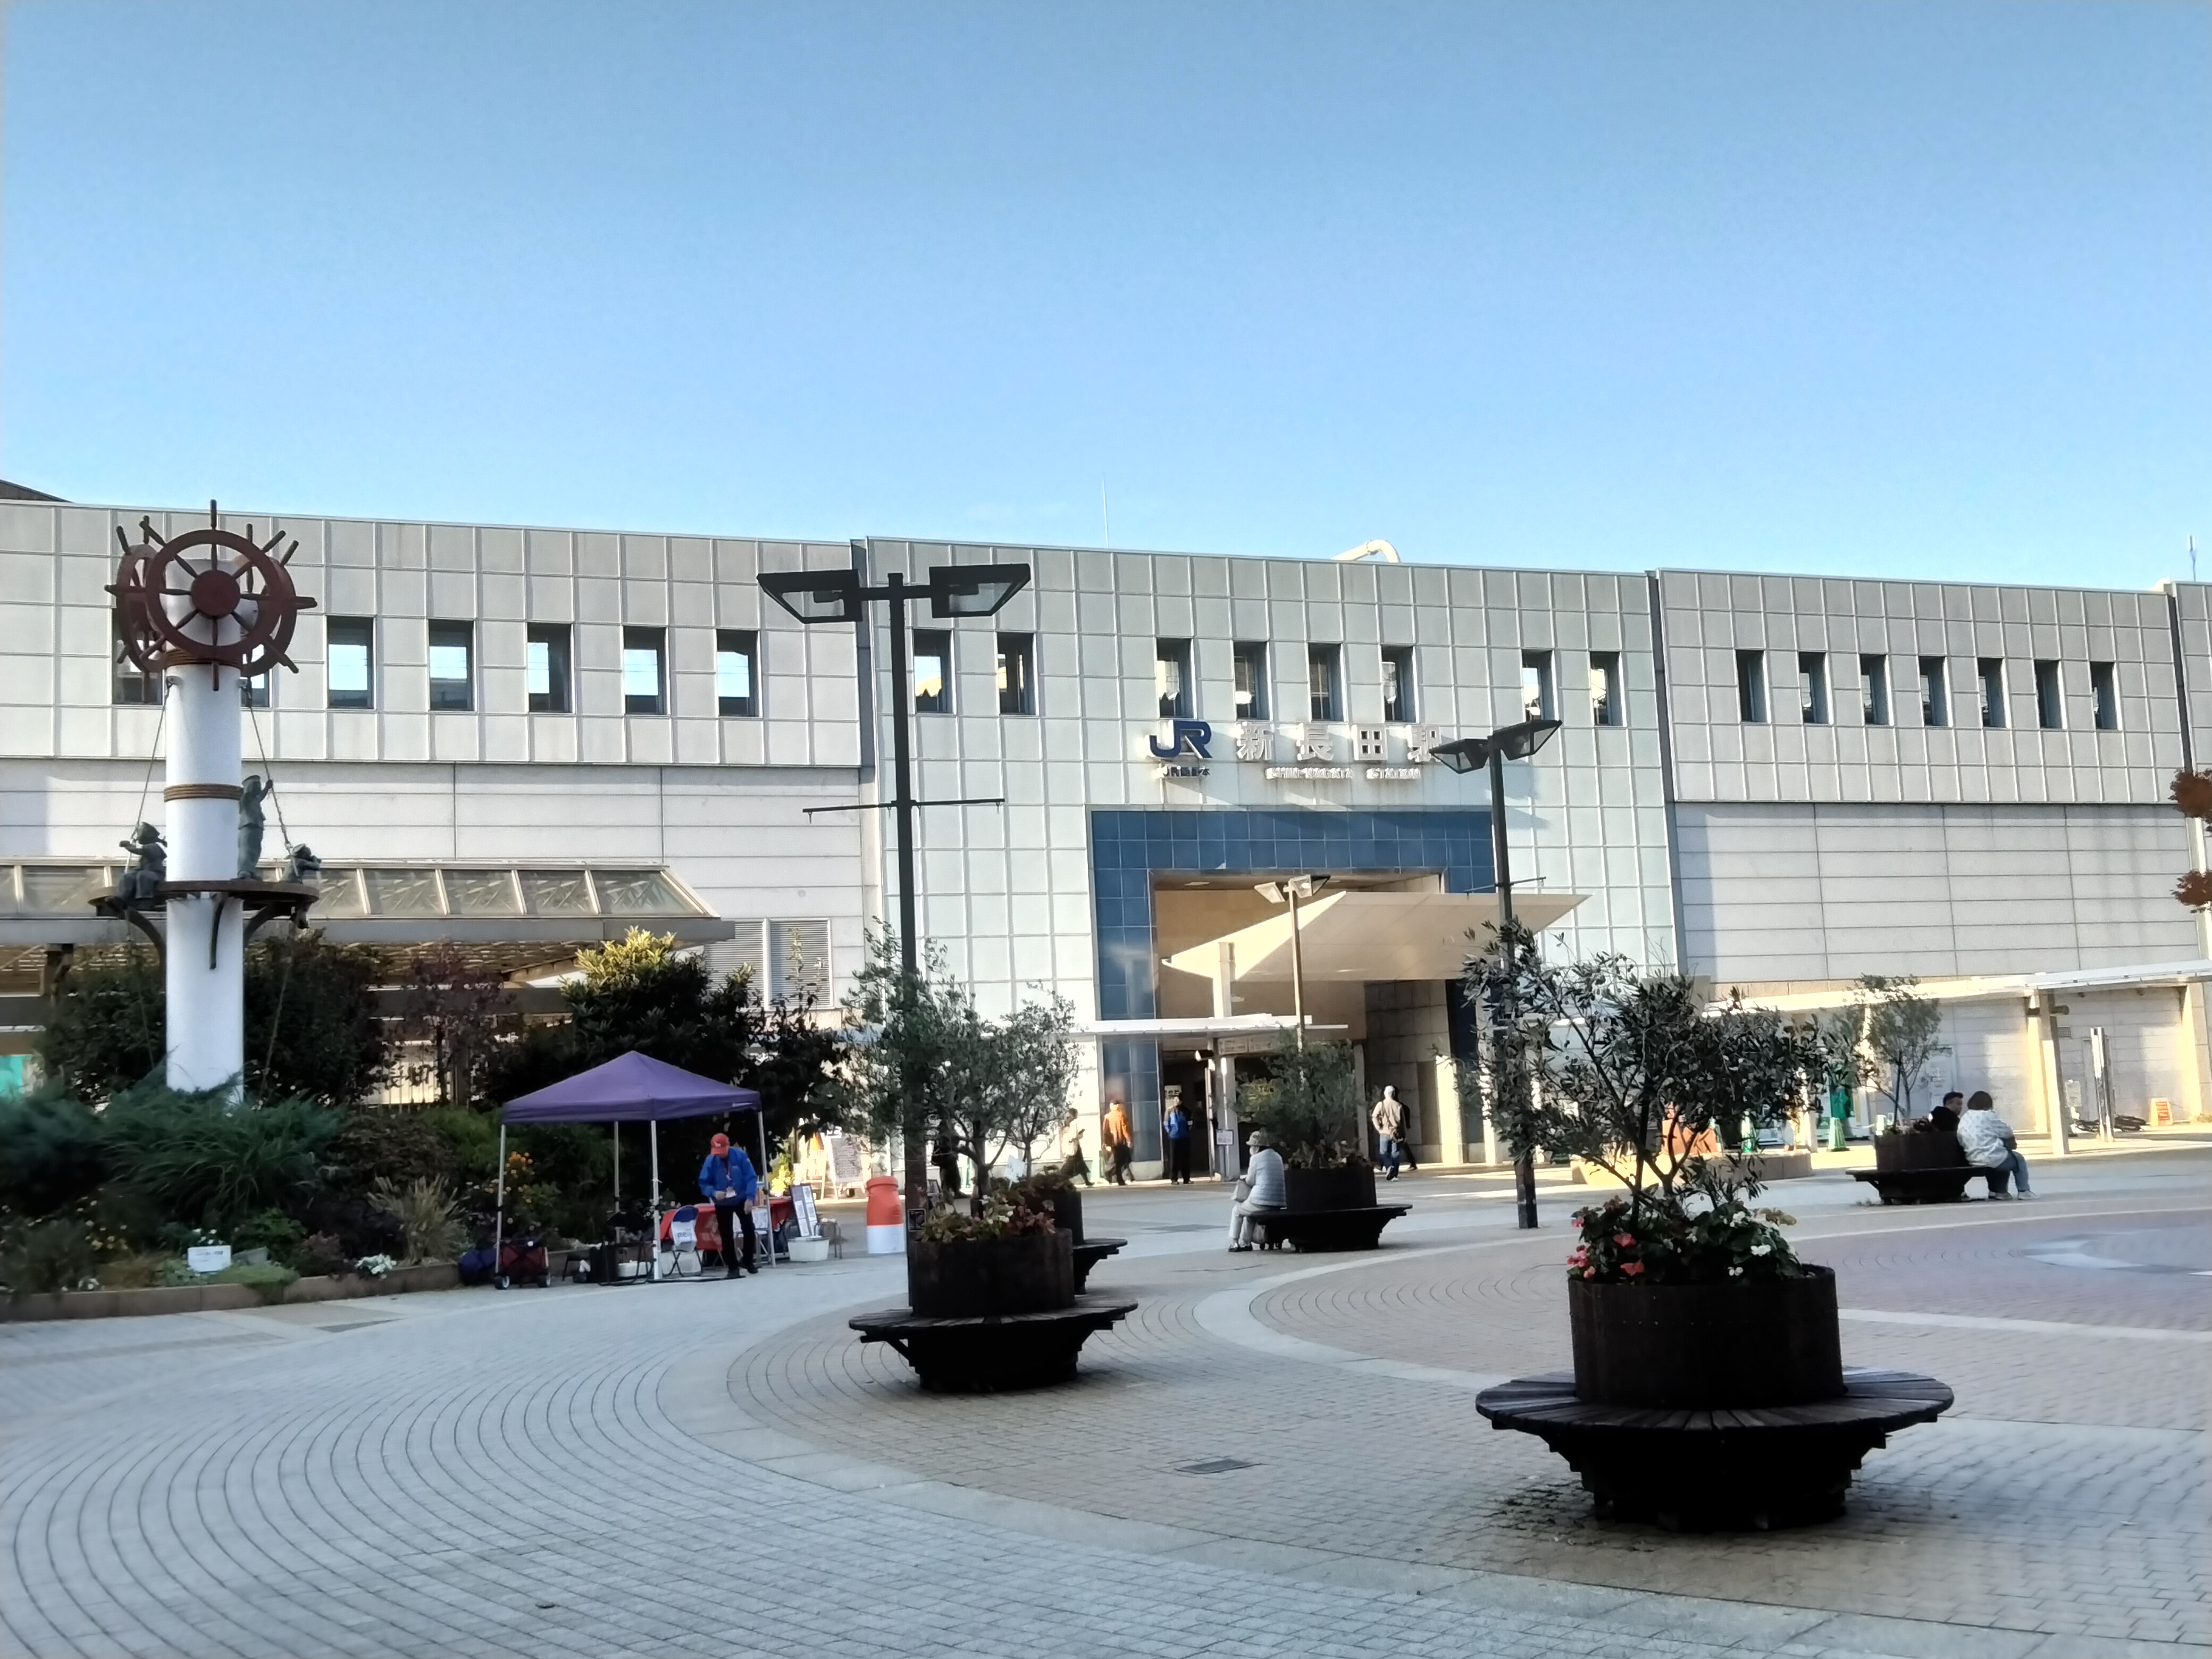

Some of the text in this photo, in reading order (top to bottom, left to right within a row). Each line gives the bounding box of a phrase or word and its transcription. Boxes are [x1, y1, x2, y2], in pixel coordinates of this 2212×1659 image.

[1149, 720, 1213, 759] JR
[1236, 722, 1443, 762] 新長田駅
[1367, 768, 1421, 780] STATION
